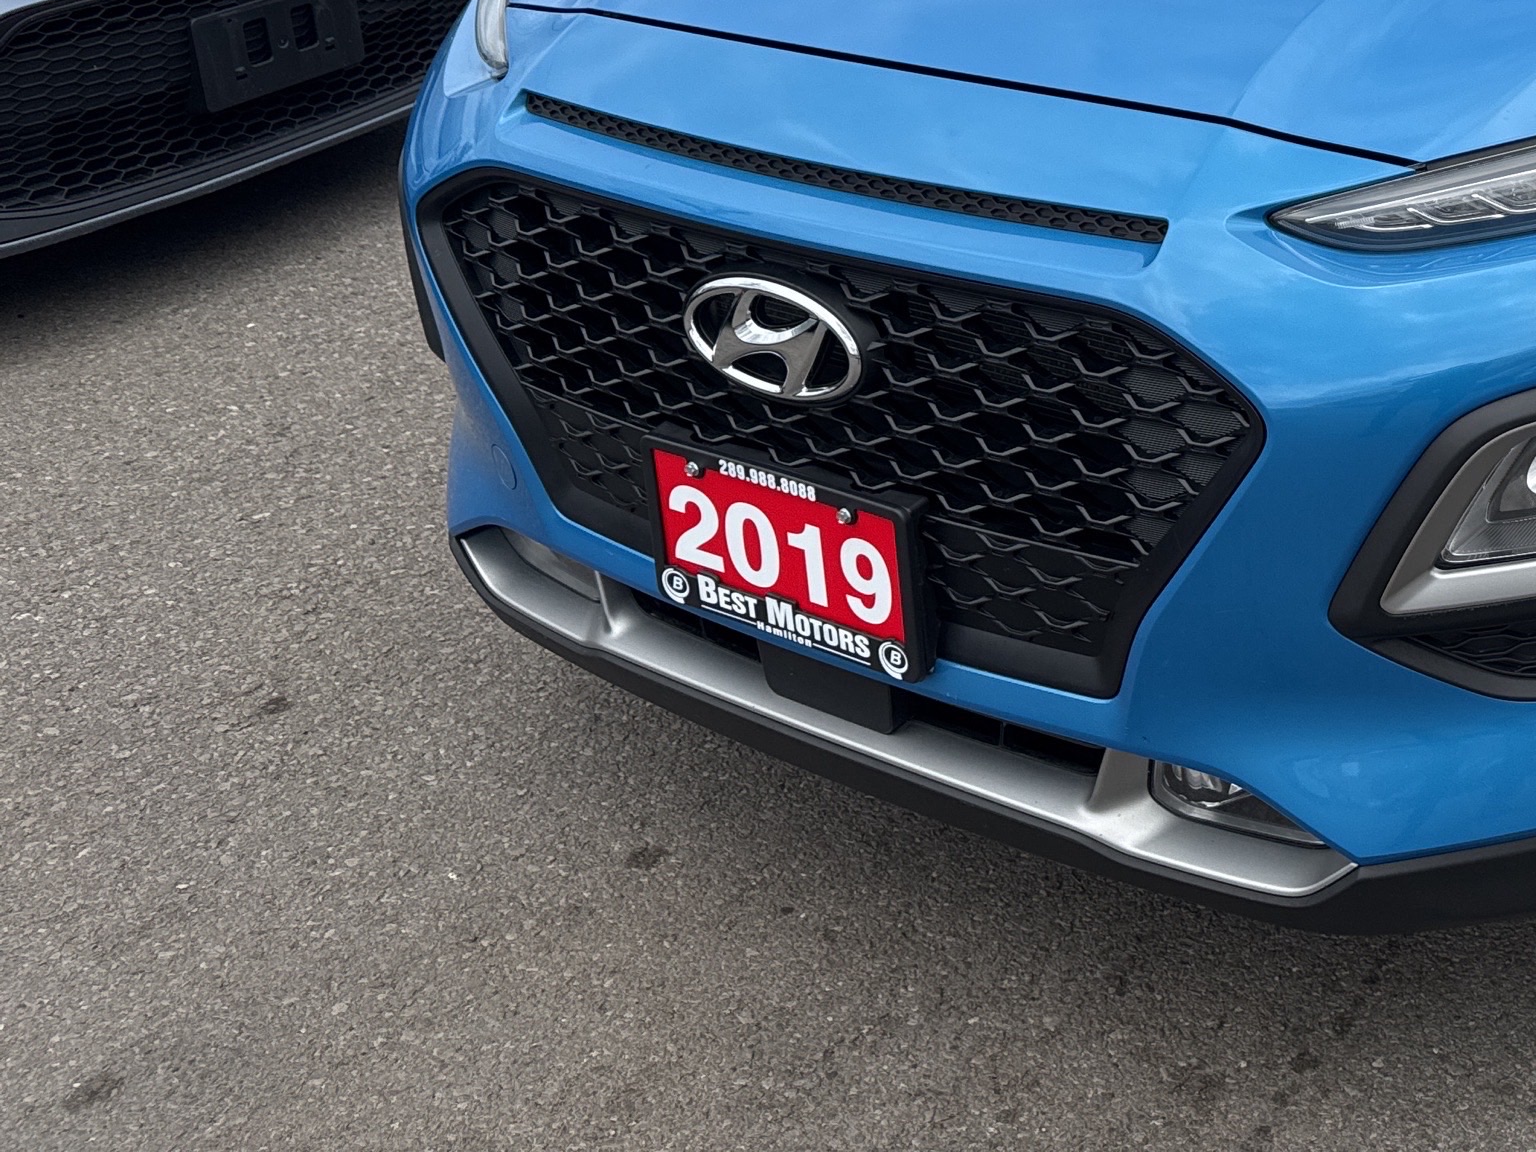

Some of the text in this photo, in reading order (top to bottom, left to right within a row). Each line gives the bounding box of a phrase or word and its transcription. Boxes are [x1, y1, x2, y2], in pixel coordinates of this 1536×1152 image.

[718, 459, 817, 502] 289.988.8088
[668, 484, 893, 625] 2019
[756, 620, 814, 648] Hamilton
